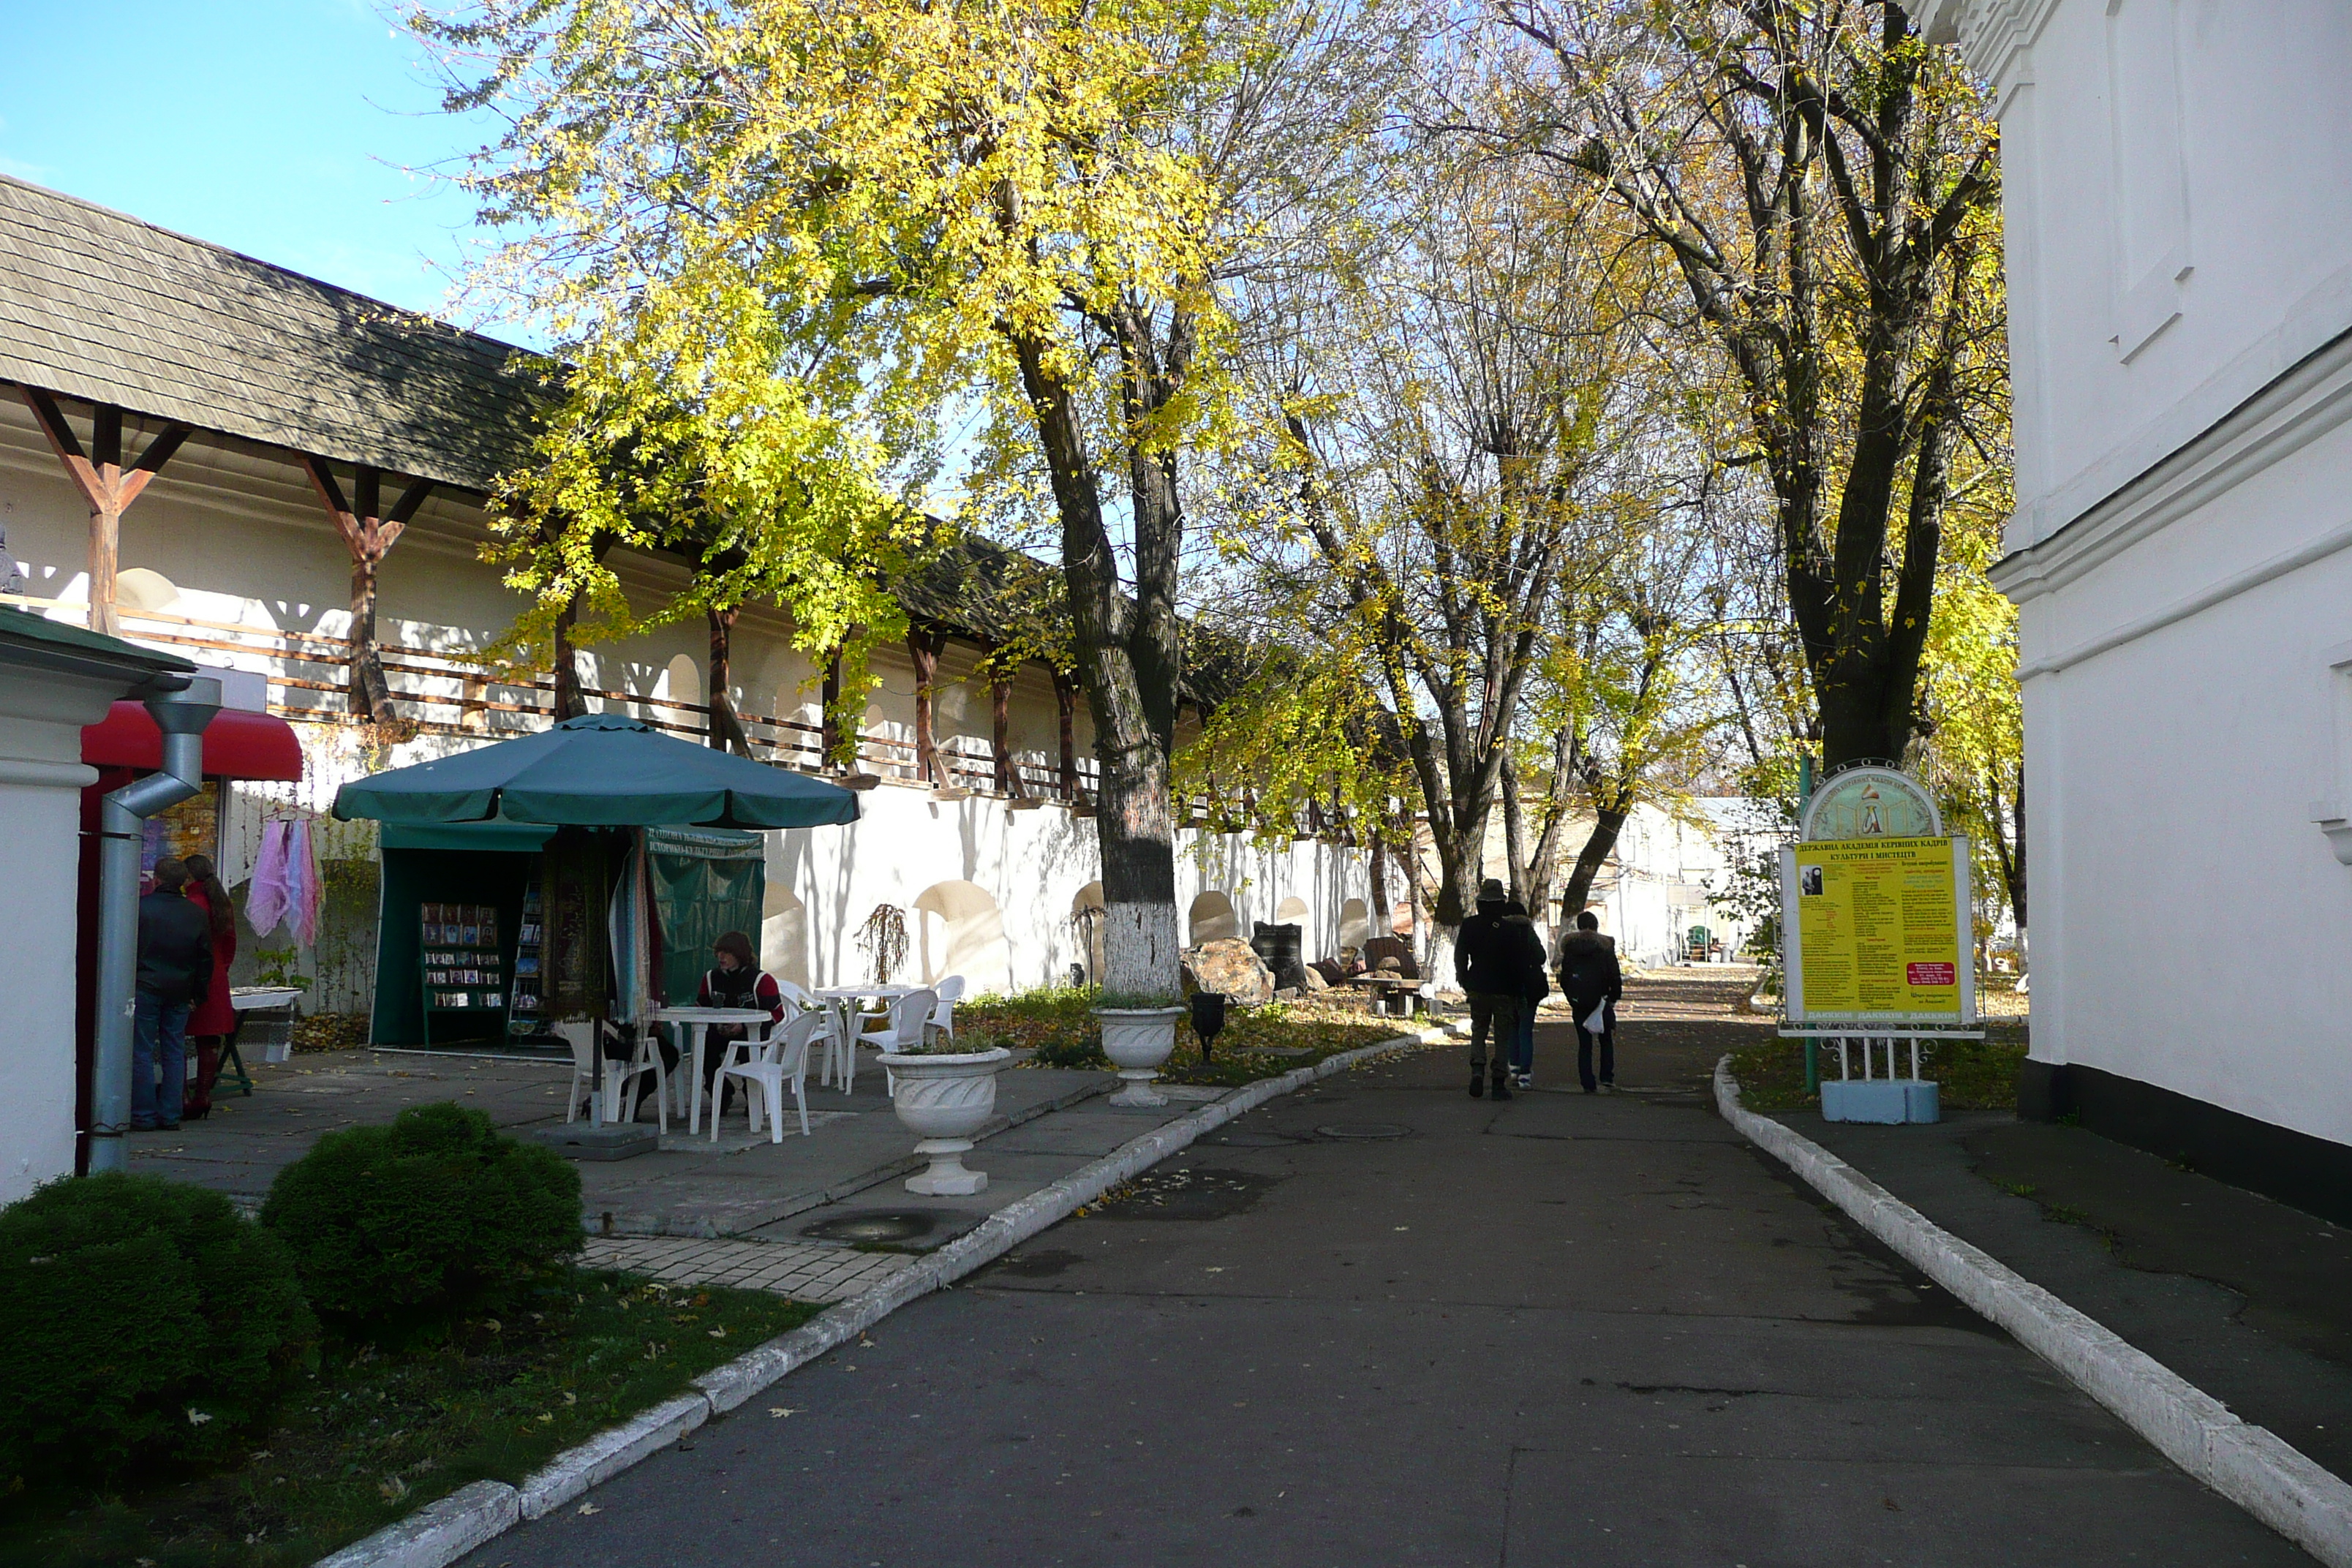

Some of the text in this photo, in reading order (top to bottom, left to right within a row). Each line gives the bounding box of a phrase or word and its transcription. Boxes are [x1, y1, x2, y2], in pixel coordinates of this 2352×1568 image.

[1799, 840, 1948, 852] ДЕРЖАВНА АКАДЕМІЯ КЕРІВНИХ КАДРІВ
[1830, 853, 1869, 861] КУЛЬТУРИ
[1876, 851, 1916, 860] МИСТЕЦТВ
